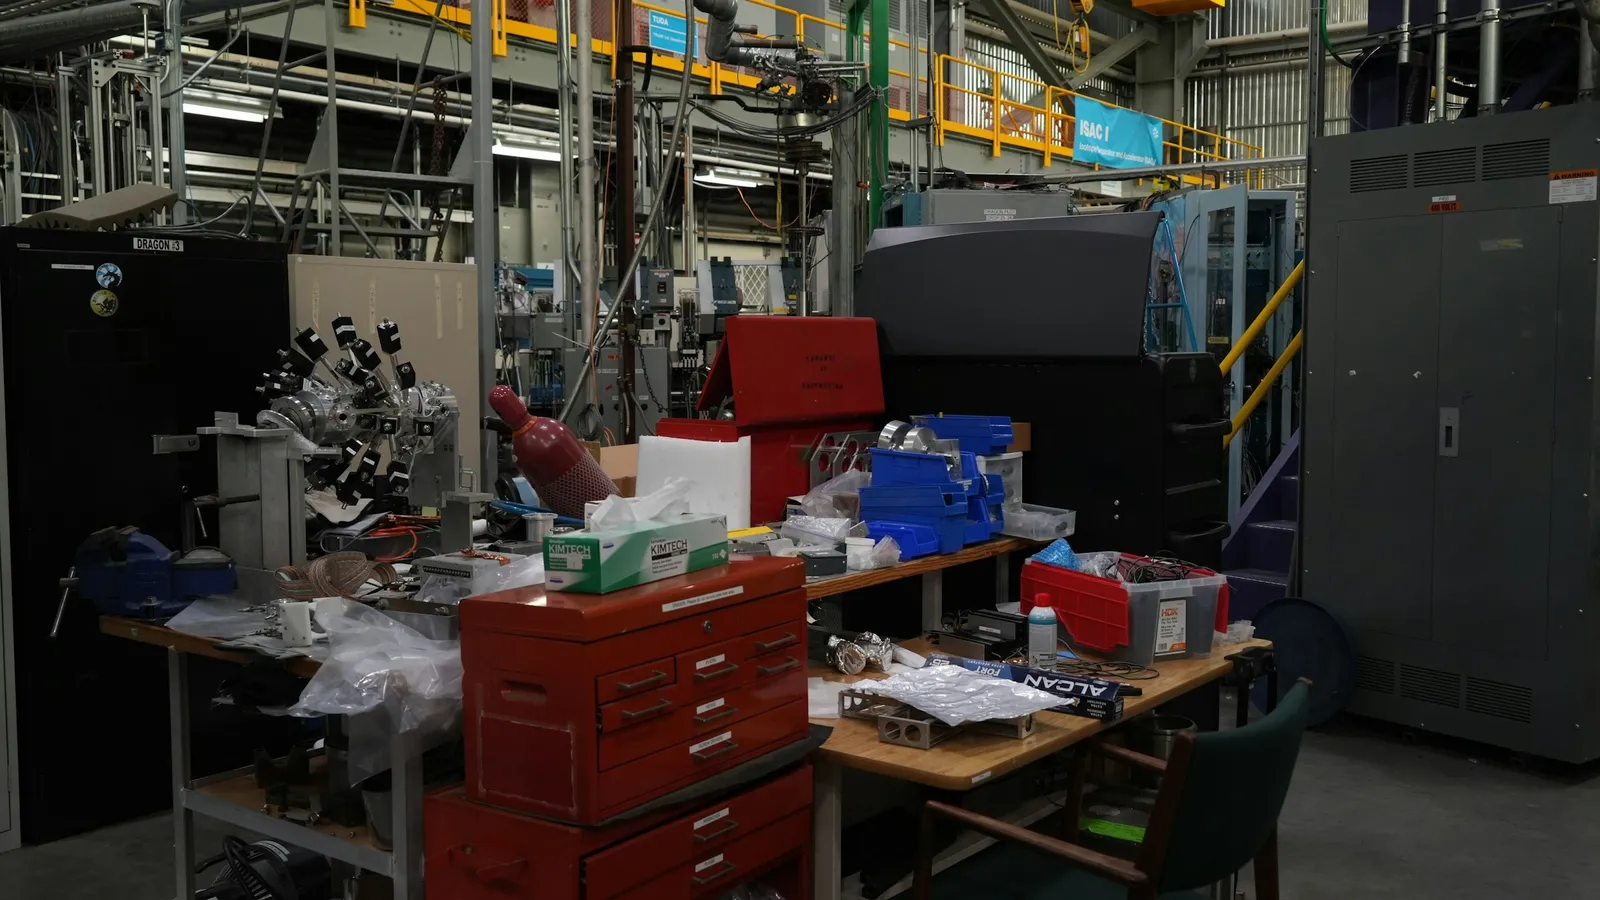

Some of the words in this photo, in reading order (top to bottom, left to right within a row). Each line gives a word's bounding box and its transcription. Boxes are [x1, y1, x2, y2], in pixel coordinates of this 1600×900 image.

[652, 15, 669, 26] TUDA
[1079, 119, 1103, 141] ISAC
[1105, 125, 1110, 142] I
[1561, 171, 1595, 179] WARNING
[1441, 202, 1457, 211] VOLTS
[137, 239, 170, 250] DRAGON
[548, 543, 591, 555] KIMTECH
[651, 539, 688, 555] KIMTECH
[975, 664, 1001, 677] FORT
[1023, 673, 1108, 697] ALCAN
